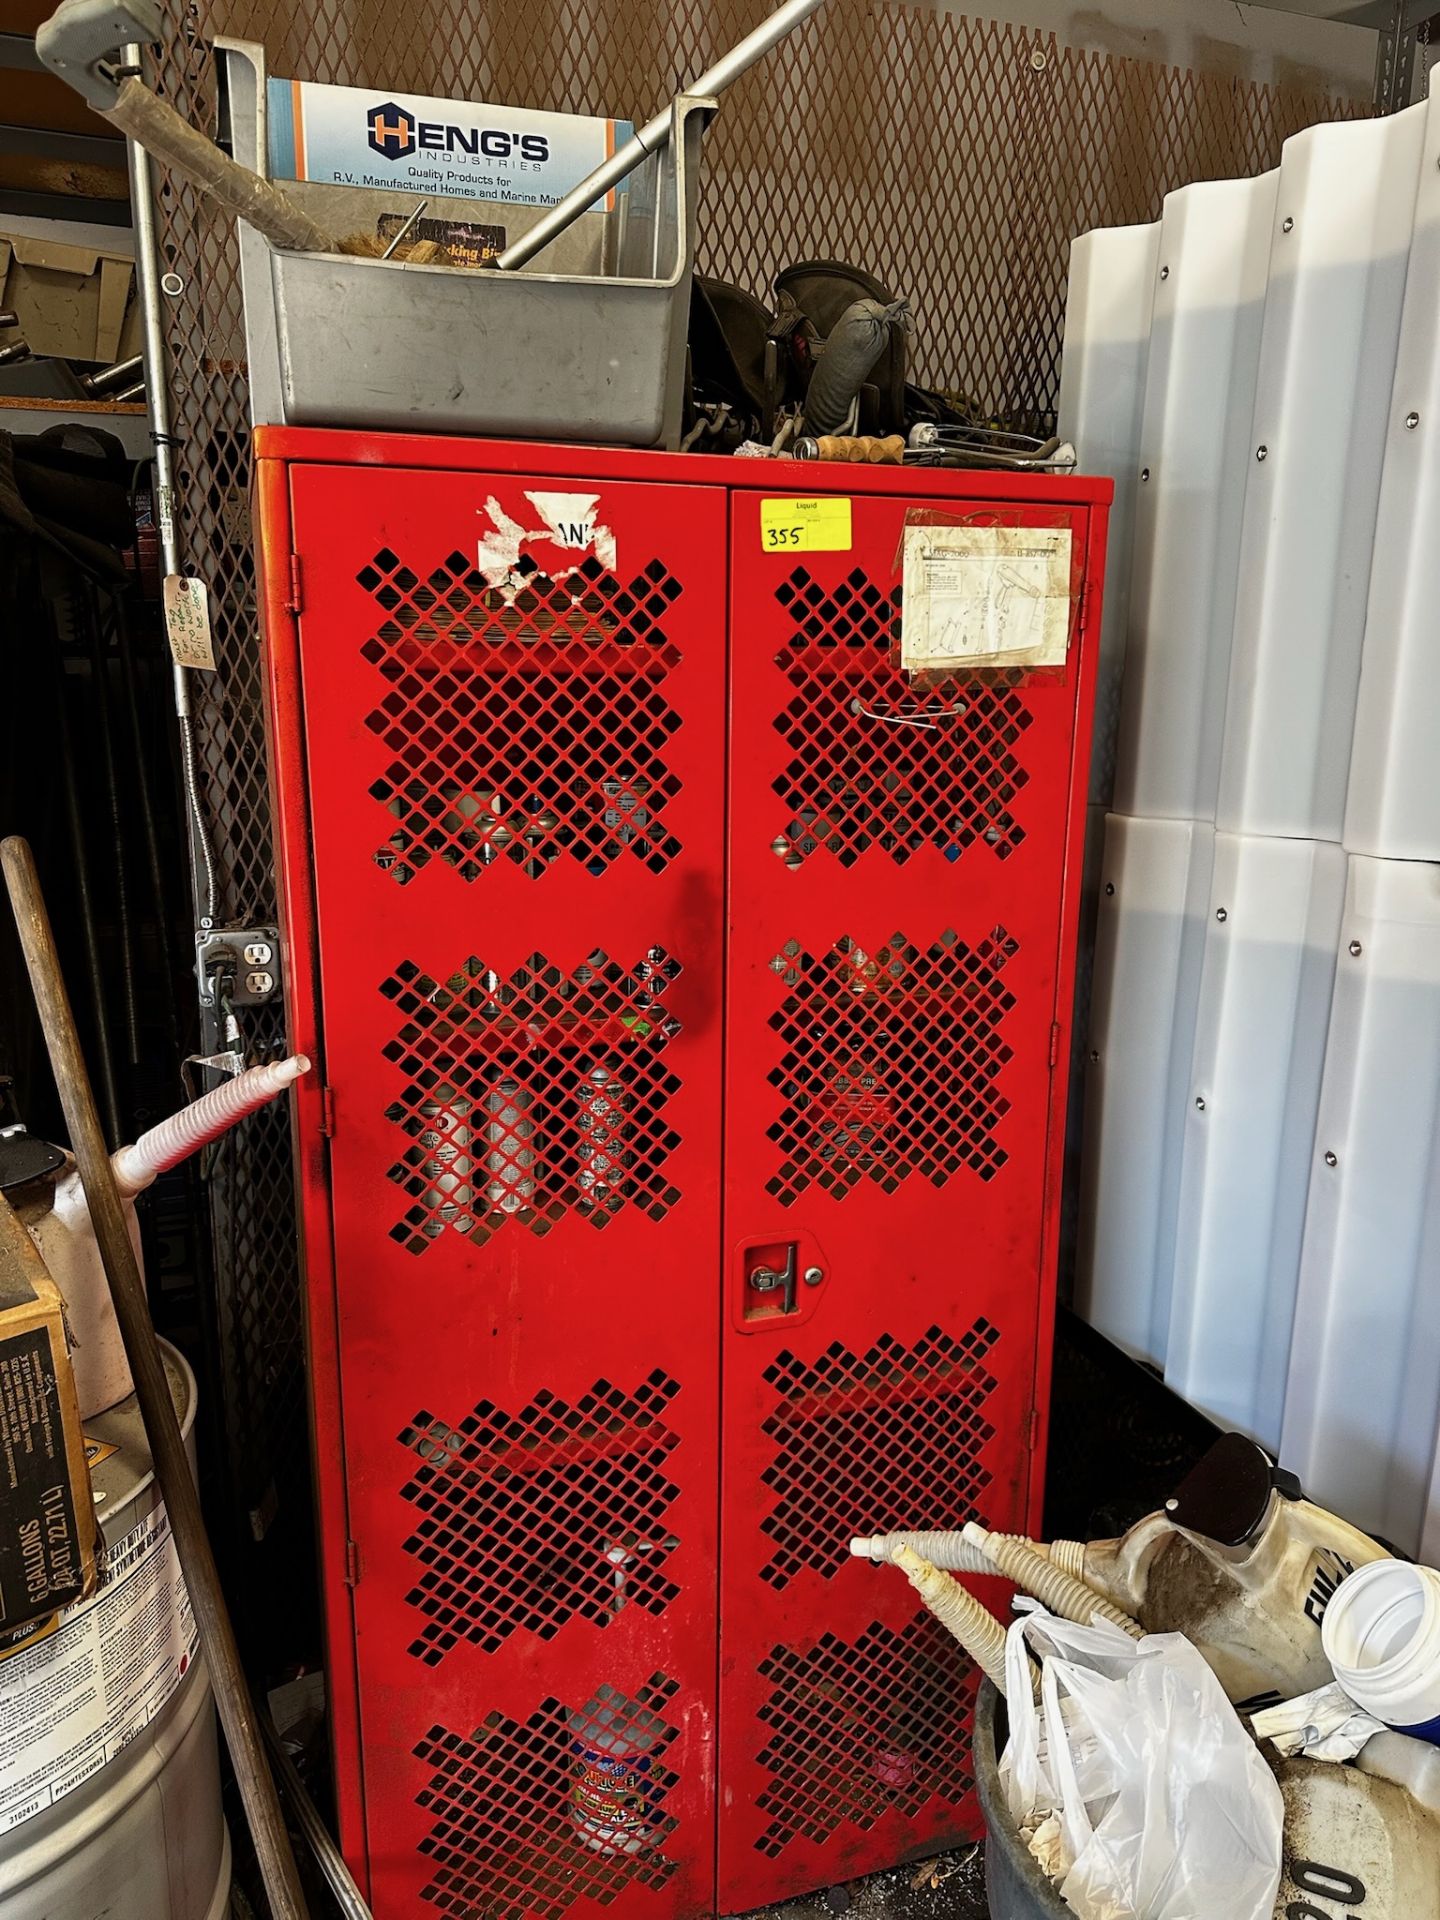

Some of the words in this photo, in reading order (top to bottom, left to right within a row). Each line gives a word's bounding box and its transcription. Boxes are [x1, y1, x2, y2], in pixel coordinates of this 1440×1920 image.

[367, 102, 549, 162] HENG'S
[418, 152, 542, 173] INDUSTRIES
[333, 171, 360, 186] R.V.,
[362, 175, 437, 193] Manufactured
[440, 182, 476, 197] Homes
[479, 186, 498, 199] and
[501, 189, 537, 203] Marine
[408, 166, 444, 181] Quality
[446, 171, 495, 185] Products
[496, 176, 512, 187] for
[796, 502, 817, 510] Liquid
[768, 527, 804, 546] 355
[44, 1503, 68, 1544] 22.71
[19, 1519, 48, 1592] GALLONS
[30, 1590, 49, 1603] 6
